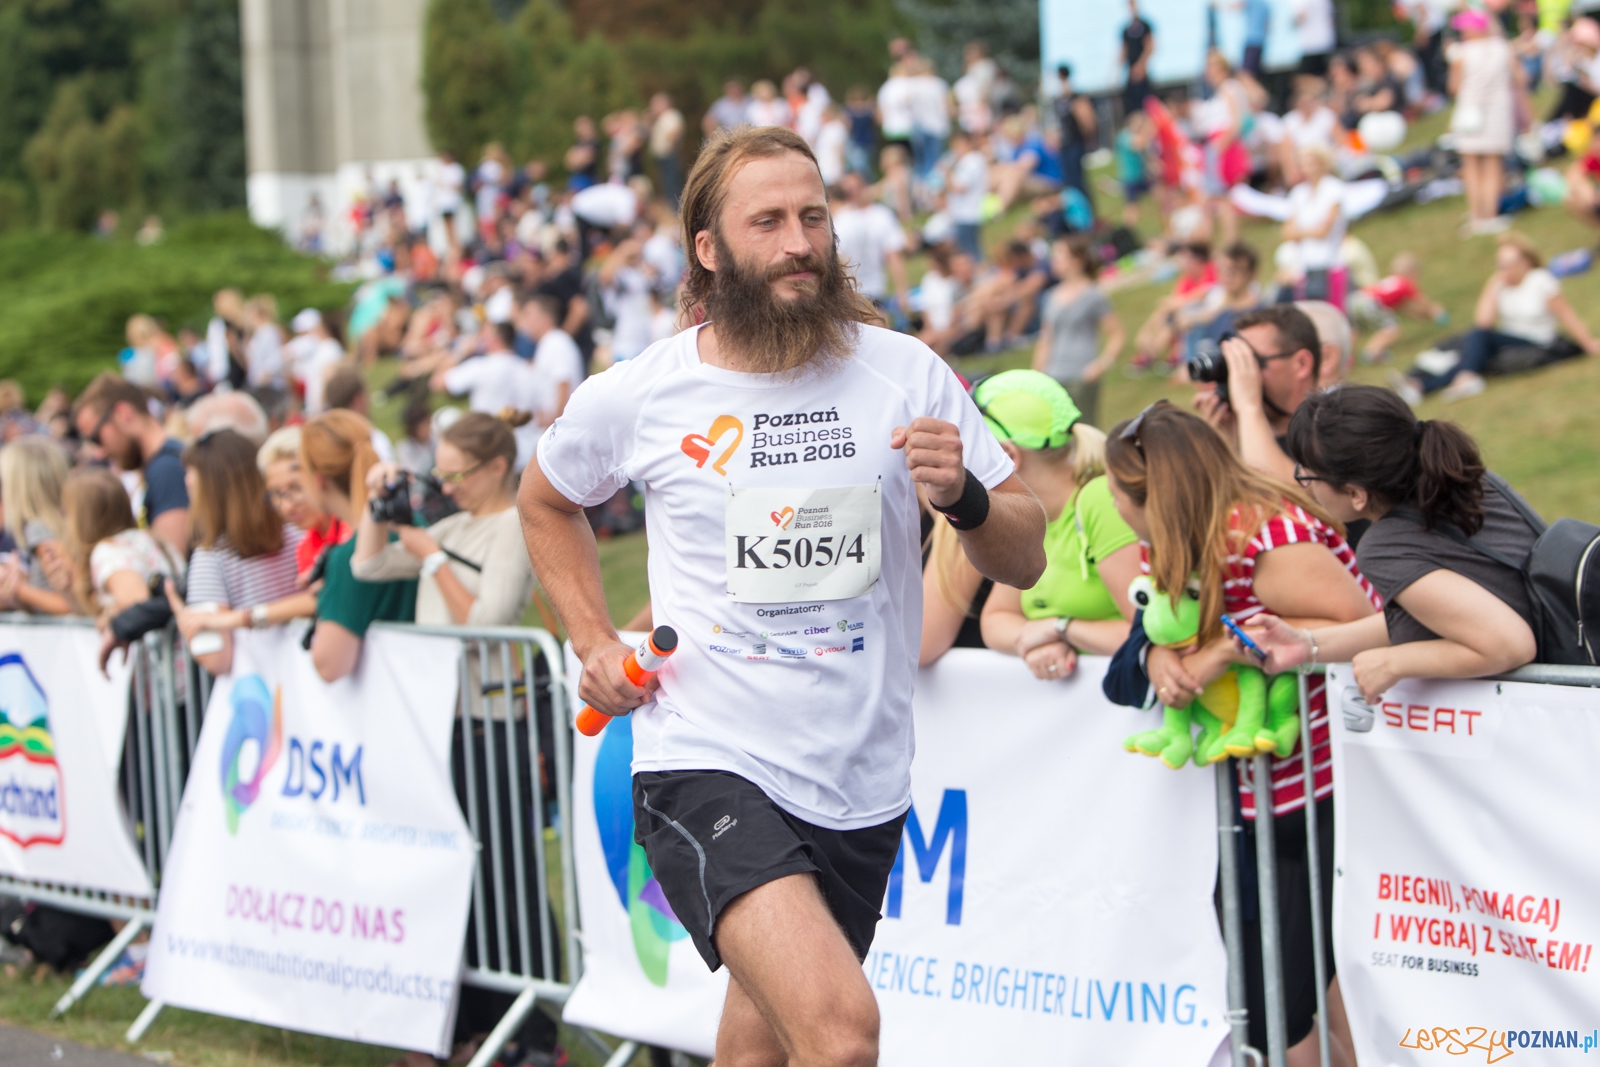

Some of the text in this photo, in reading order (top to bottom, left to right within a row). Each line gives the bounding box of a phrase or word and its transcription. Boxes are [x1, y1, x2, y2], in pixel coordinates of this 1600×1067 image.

[753, 406, 840, 431] Poznań
[751, 427, 853, 449] Business
[750, 442, 856, 468] Run 2016
[795, 513, 833, 521] Business
[797, 505, 829, 514] Poznań
[813, 520, 833, 528] 2016
[733, 533, 865, 569] K505/4
[756, 604, 825, 618] Organizatorzy:
[803, 626, 831, 636] ciber
[823, 646, 847, 654] VEOLIA
[1381, 702, 1482, 736] SEAT
[281, 736, 366, 807] DSM
[225, 884, 406, 944] DOŁĄCZ DO NAS
[1377, 872, 1561, 933] BIEGNIJ, POMAGAJ
[1373, 912, 1594, 974] I WYGRAJ Z SEAT-EM!
[1370, 951, 1479, 978] SEAT FOR BUSINESS
[867, 949, 1210, 1029] IENCE. BRIGHTER LIVING.
